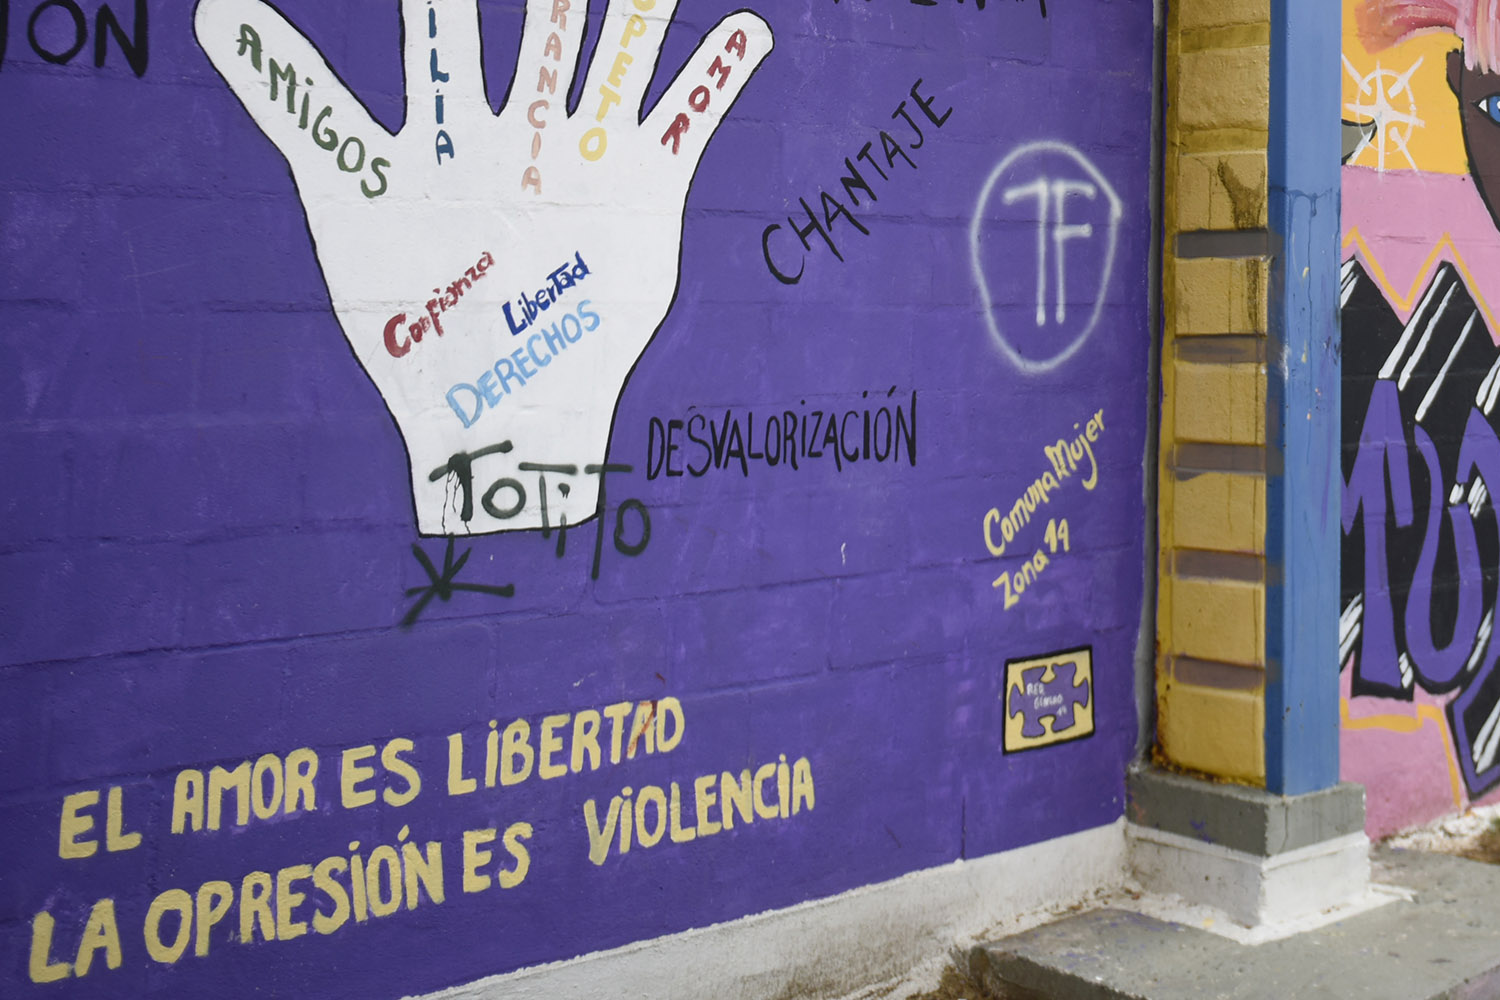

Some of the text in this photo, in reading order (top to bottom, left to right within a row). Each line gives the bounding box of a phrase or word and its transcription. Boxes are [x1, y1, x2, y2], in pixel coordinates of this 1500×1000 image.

[236, 22, 392, 199] AMIGOS
[761, 78, 954, 286] CHANTAJE
[445, 298, 601, 429] DERECHOS
[646, 385, 917, 481] DESVALORIZACIÓN
[991, 548, 1050, 610] Zona
[58, 695, 686, 860] EL AMOR ES LIBERTAD
[28, 753, 816, 985] LA OPRESIÓN ES VIOLENCIA
